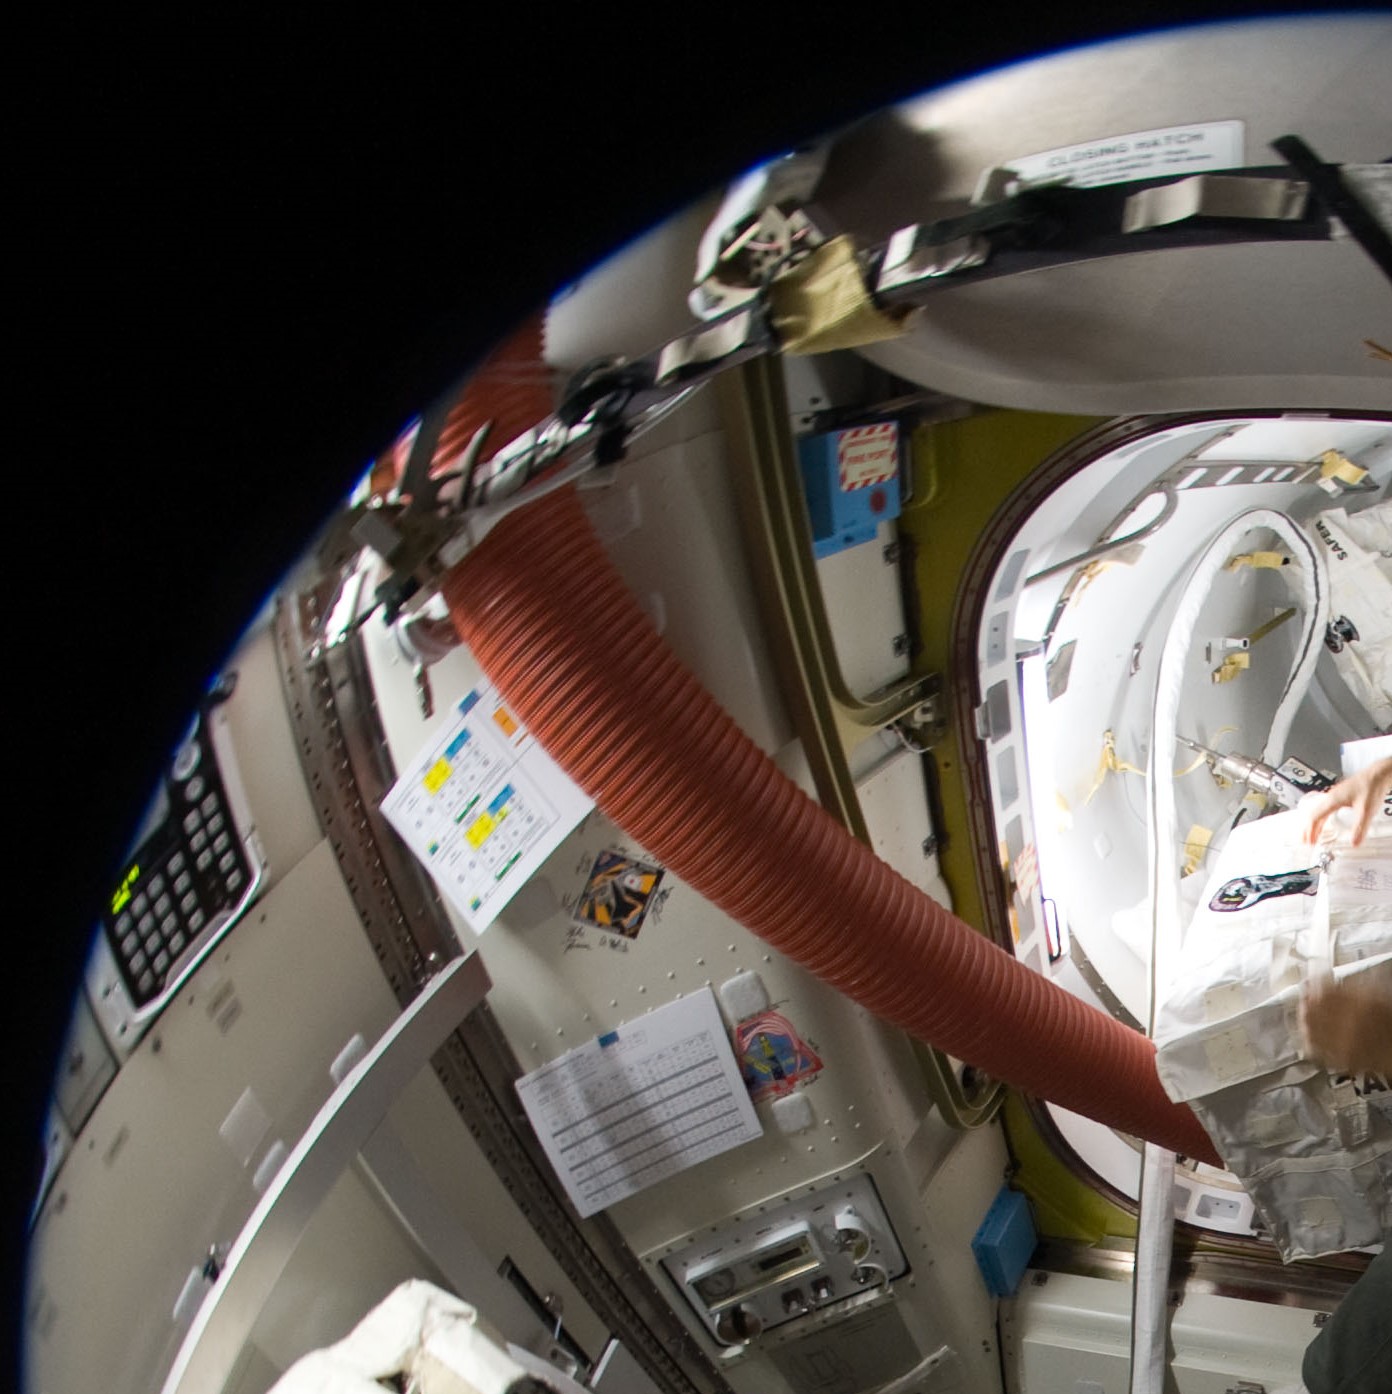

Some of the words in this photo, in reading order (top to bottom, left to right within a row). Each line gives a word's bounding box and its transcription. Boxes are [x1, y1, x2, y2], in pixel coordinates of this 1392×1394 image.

[1047, 144, 1130, 167] CLOSING
[1136, 132, 1204, 151] HATCH
[1315, 520, 1348, 561] SAFER
